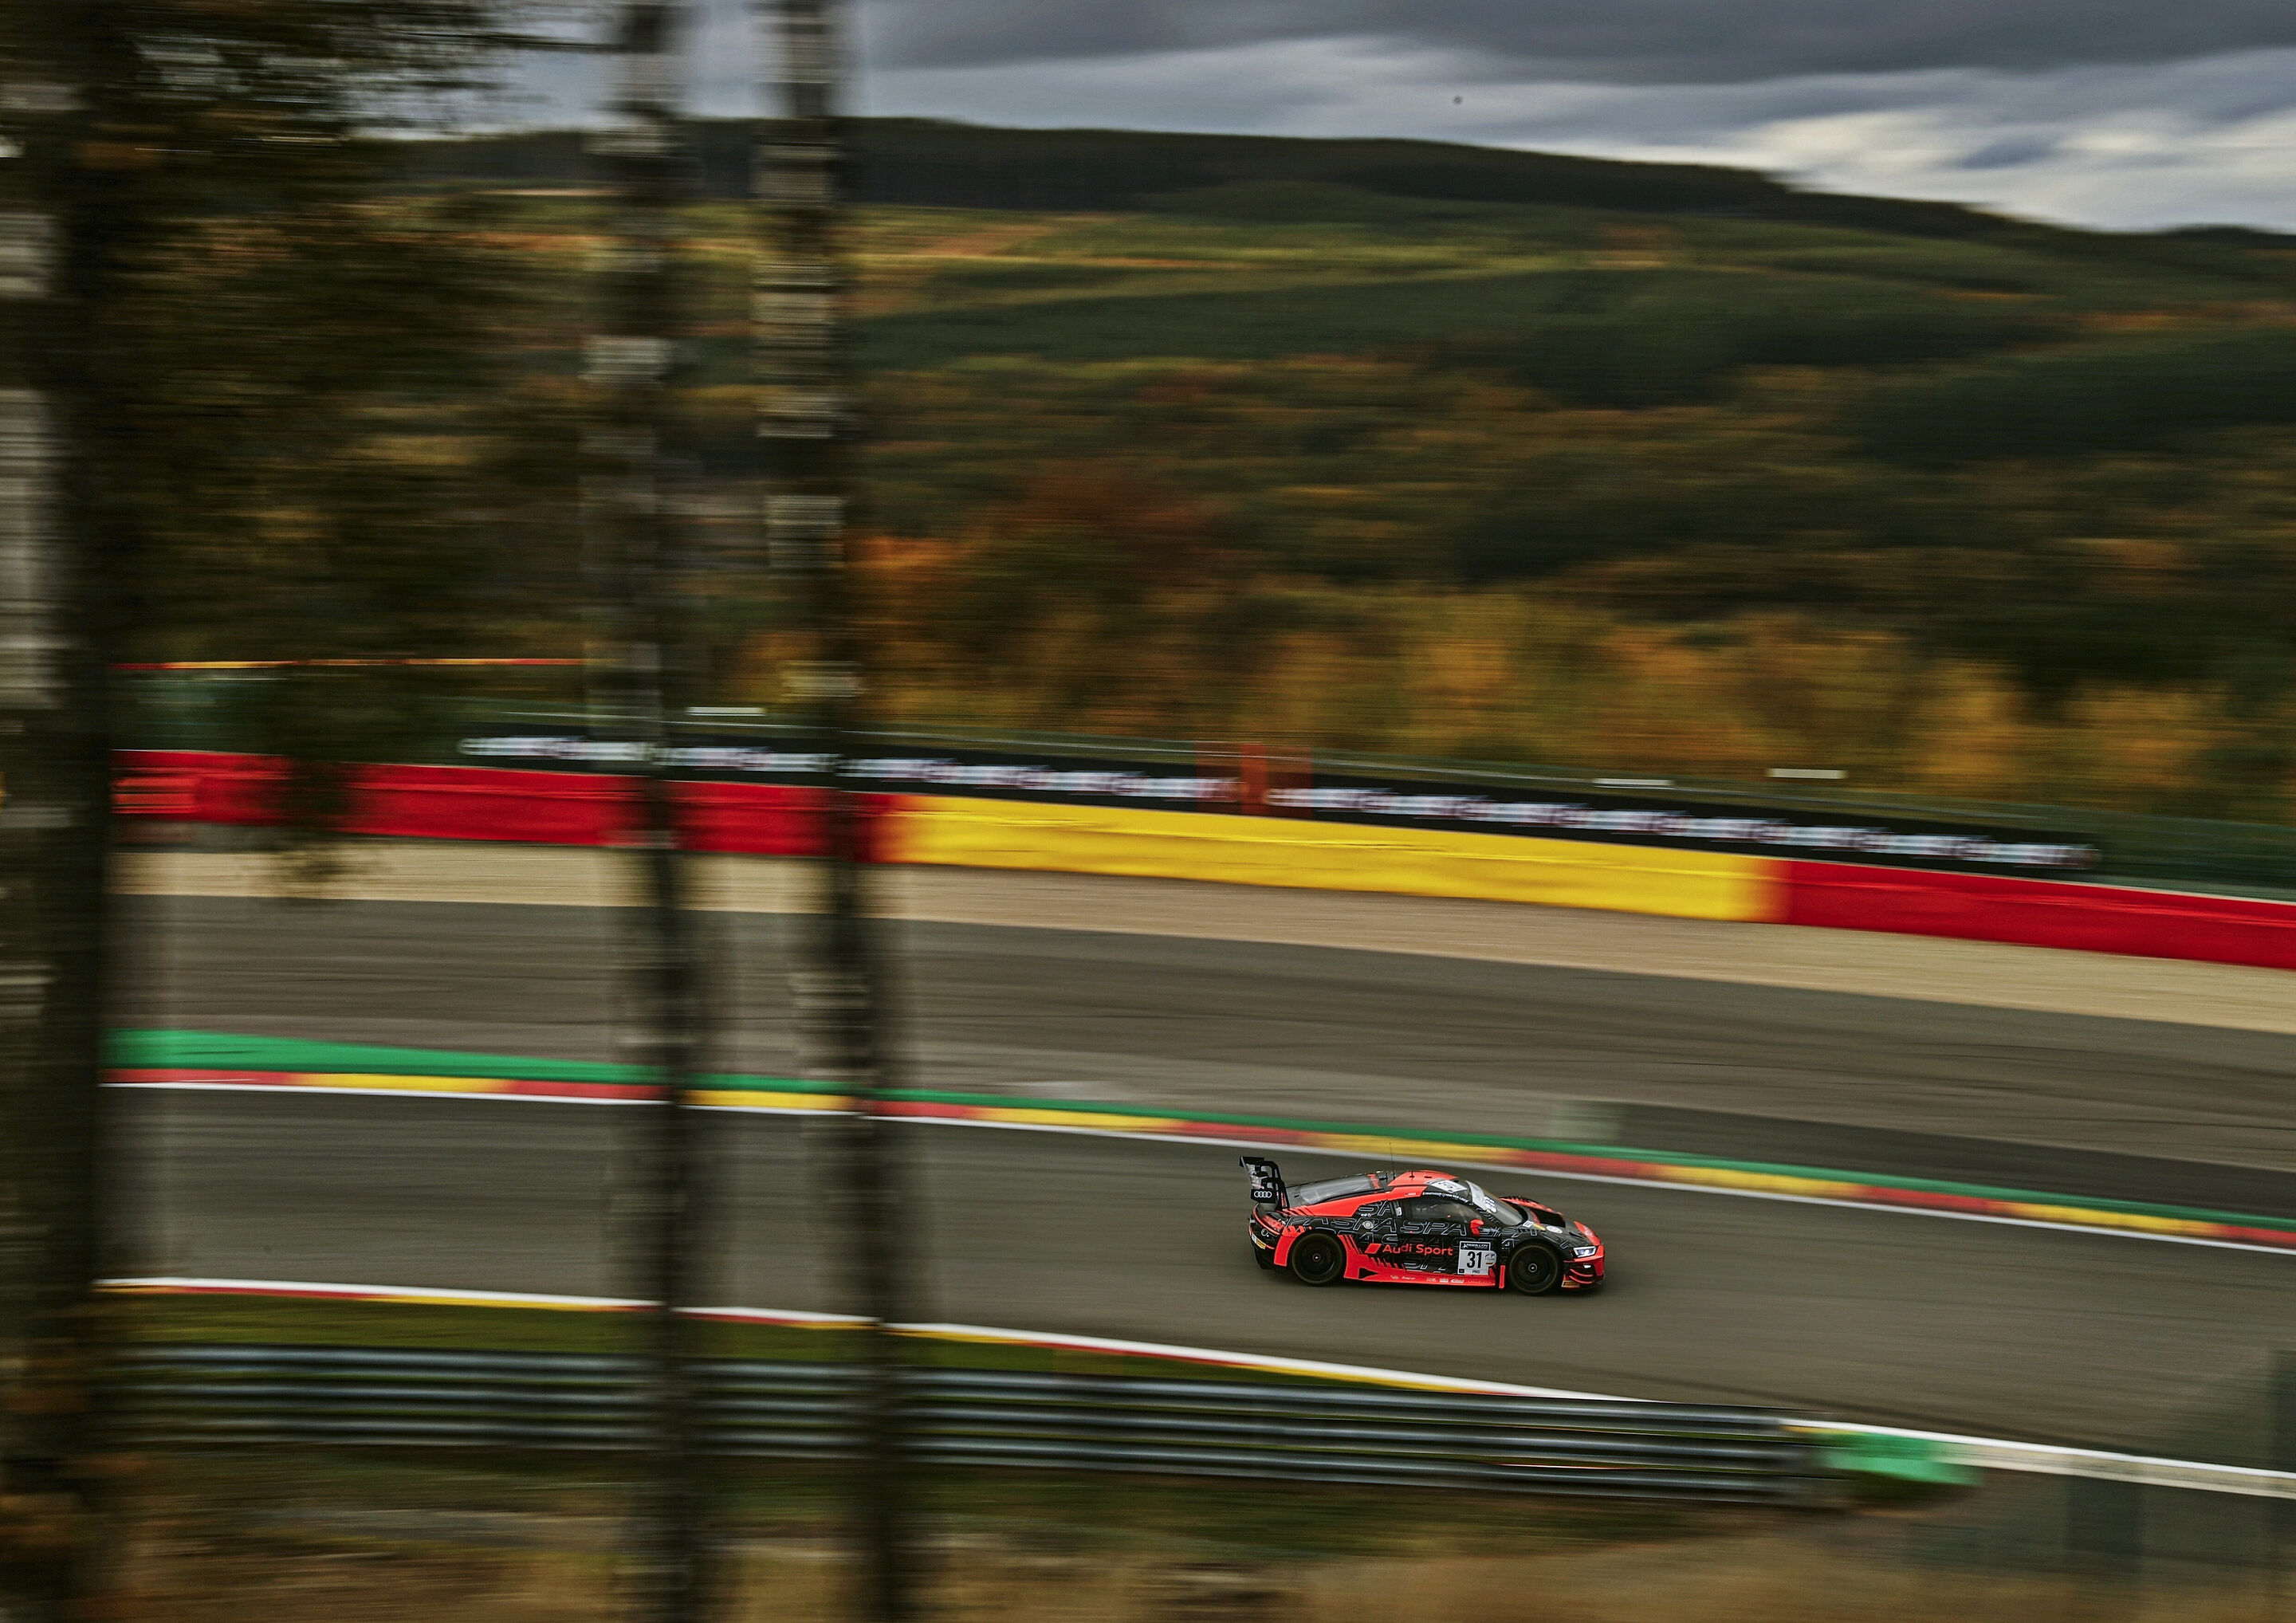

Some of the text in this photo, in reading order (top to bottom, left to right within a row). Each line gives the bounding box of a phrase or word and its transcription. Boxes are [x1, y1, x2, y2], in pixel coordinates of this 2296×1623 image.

[1400, 1220, 1468, 1236] SPA
[1382, 1244, 1453, 1256] Audi Sport
[1466, 1251, 1483, 1269] 31
